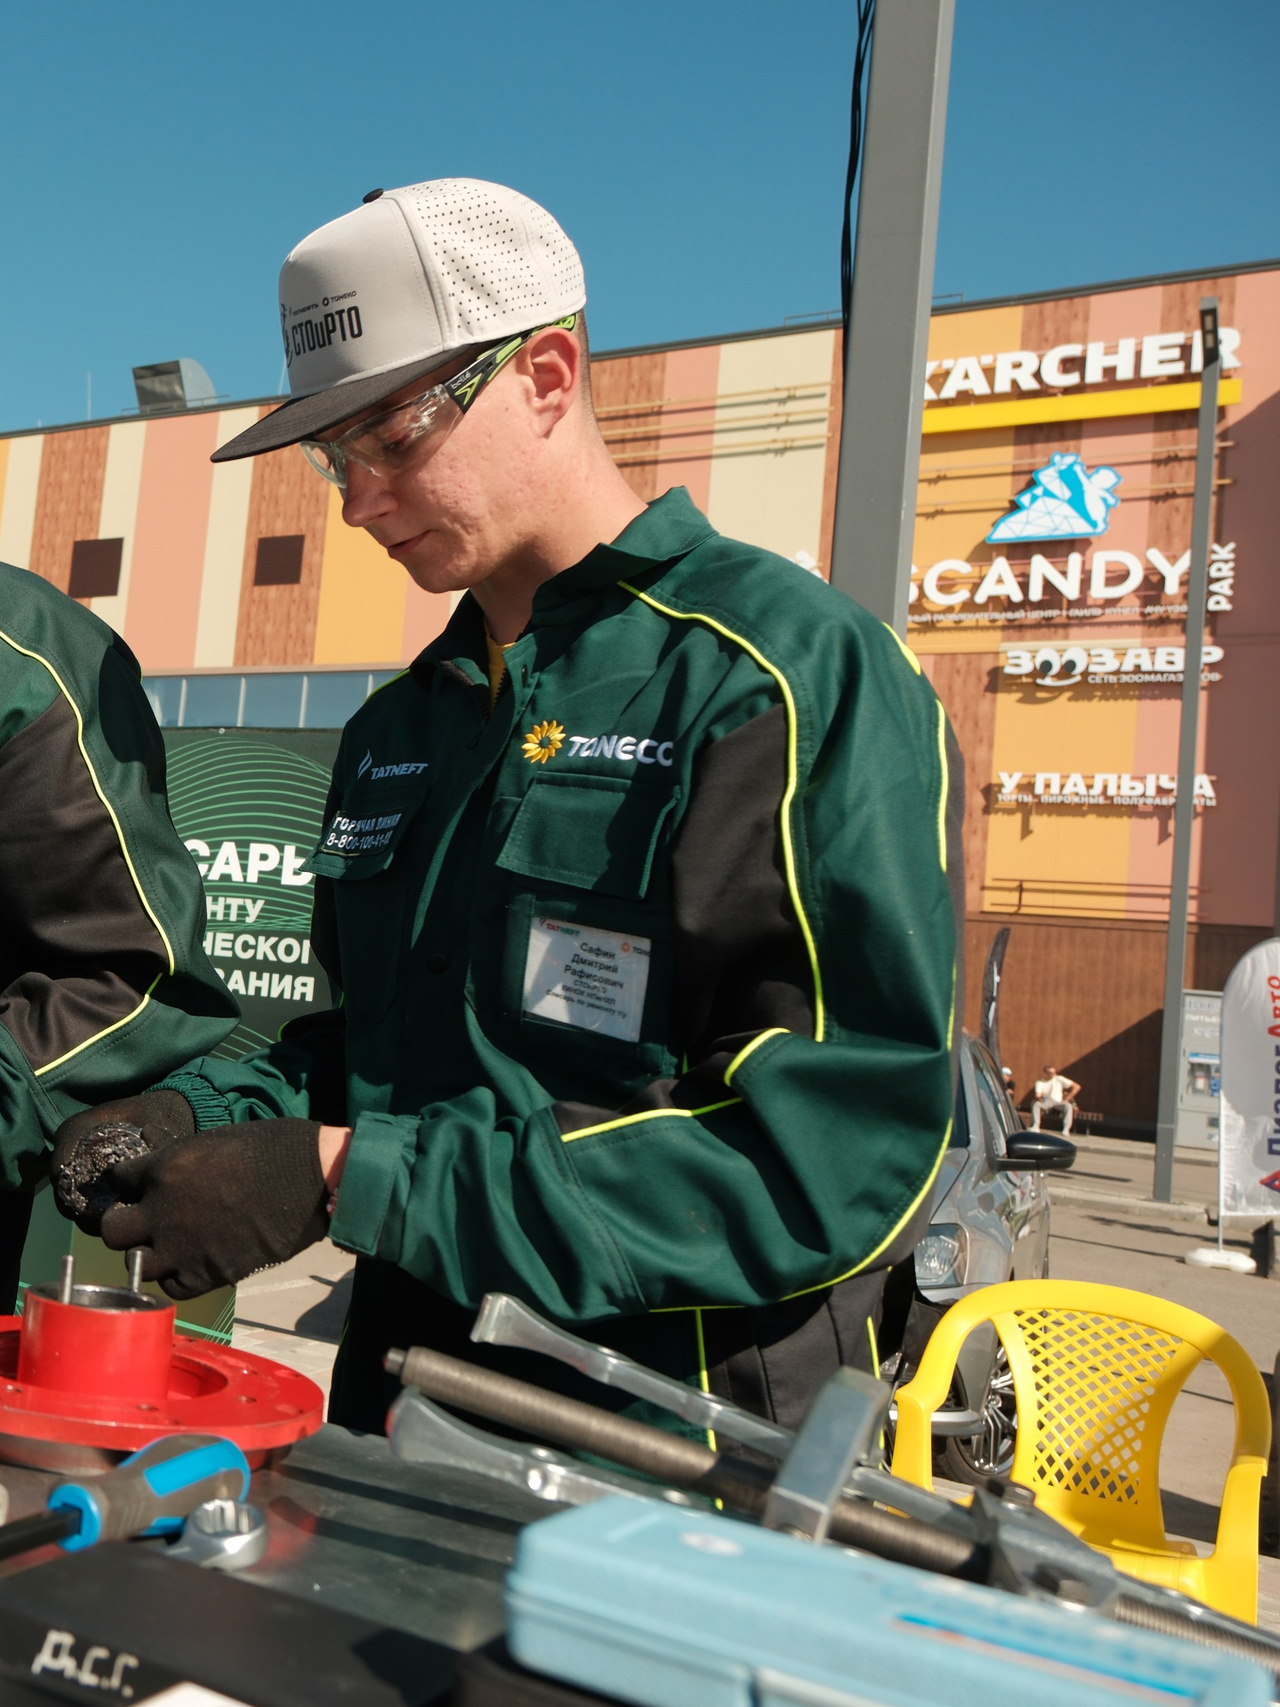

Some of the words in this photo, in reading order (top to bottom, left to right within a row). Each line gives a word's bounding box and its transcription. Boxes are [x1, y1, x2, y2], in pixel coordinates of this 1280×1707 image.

[1207, 542, 1236, 611] PARK
[1087, 674, 1116, 684] СЕТЬ
[1119, 671, 1221, 683] ЗООМАГАЗОВ
[371, 763, 429, 780] TATNEFT
[998, 772, 1023, 794] У
[1034, 772, 1216, 798] ПАЛЫЧА
[332, 816, 376, 832] ГОРЯЧАЯ
[206, 896, 265, 923] НТУ
[580, 942, 616, 960] Сафин
[571, 953, 619, 974] Дмитрий
[564, 964, 624, 989] Рафисович
